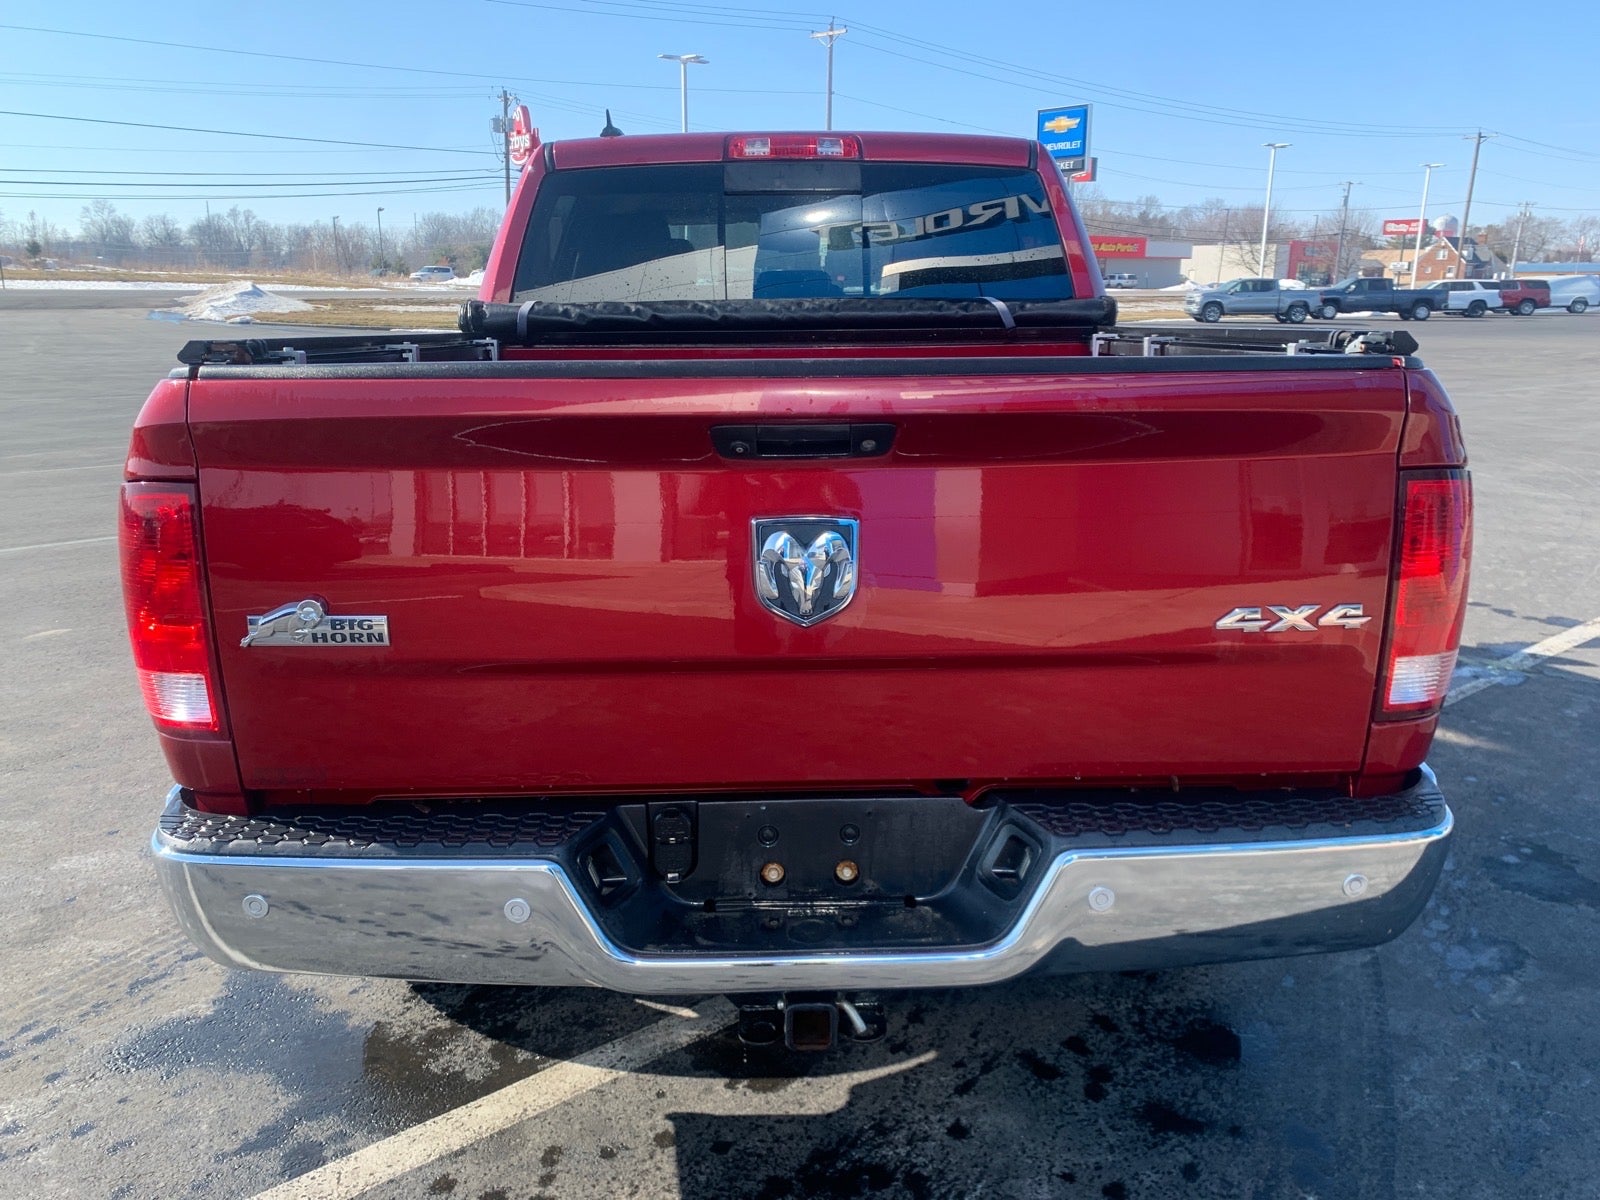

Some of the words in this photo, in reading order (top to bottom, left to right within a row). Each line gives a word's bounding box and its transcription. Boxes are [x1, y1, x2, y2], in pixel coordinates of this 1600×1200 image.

[510, 134, 530, 153] rbys
[1044, 140, 1082, 151] HEVROLET
[1215, 603, 1373, 633] 4X4
[330, 619, 374, 631] BIG
[311, 632, 385, 644] HORN
